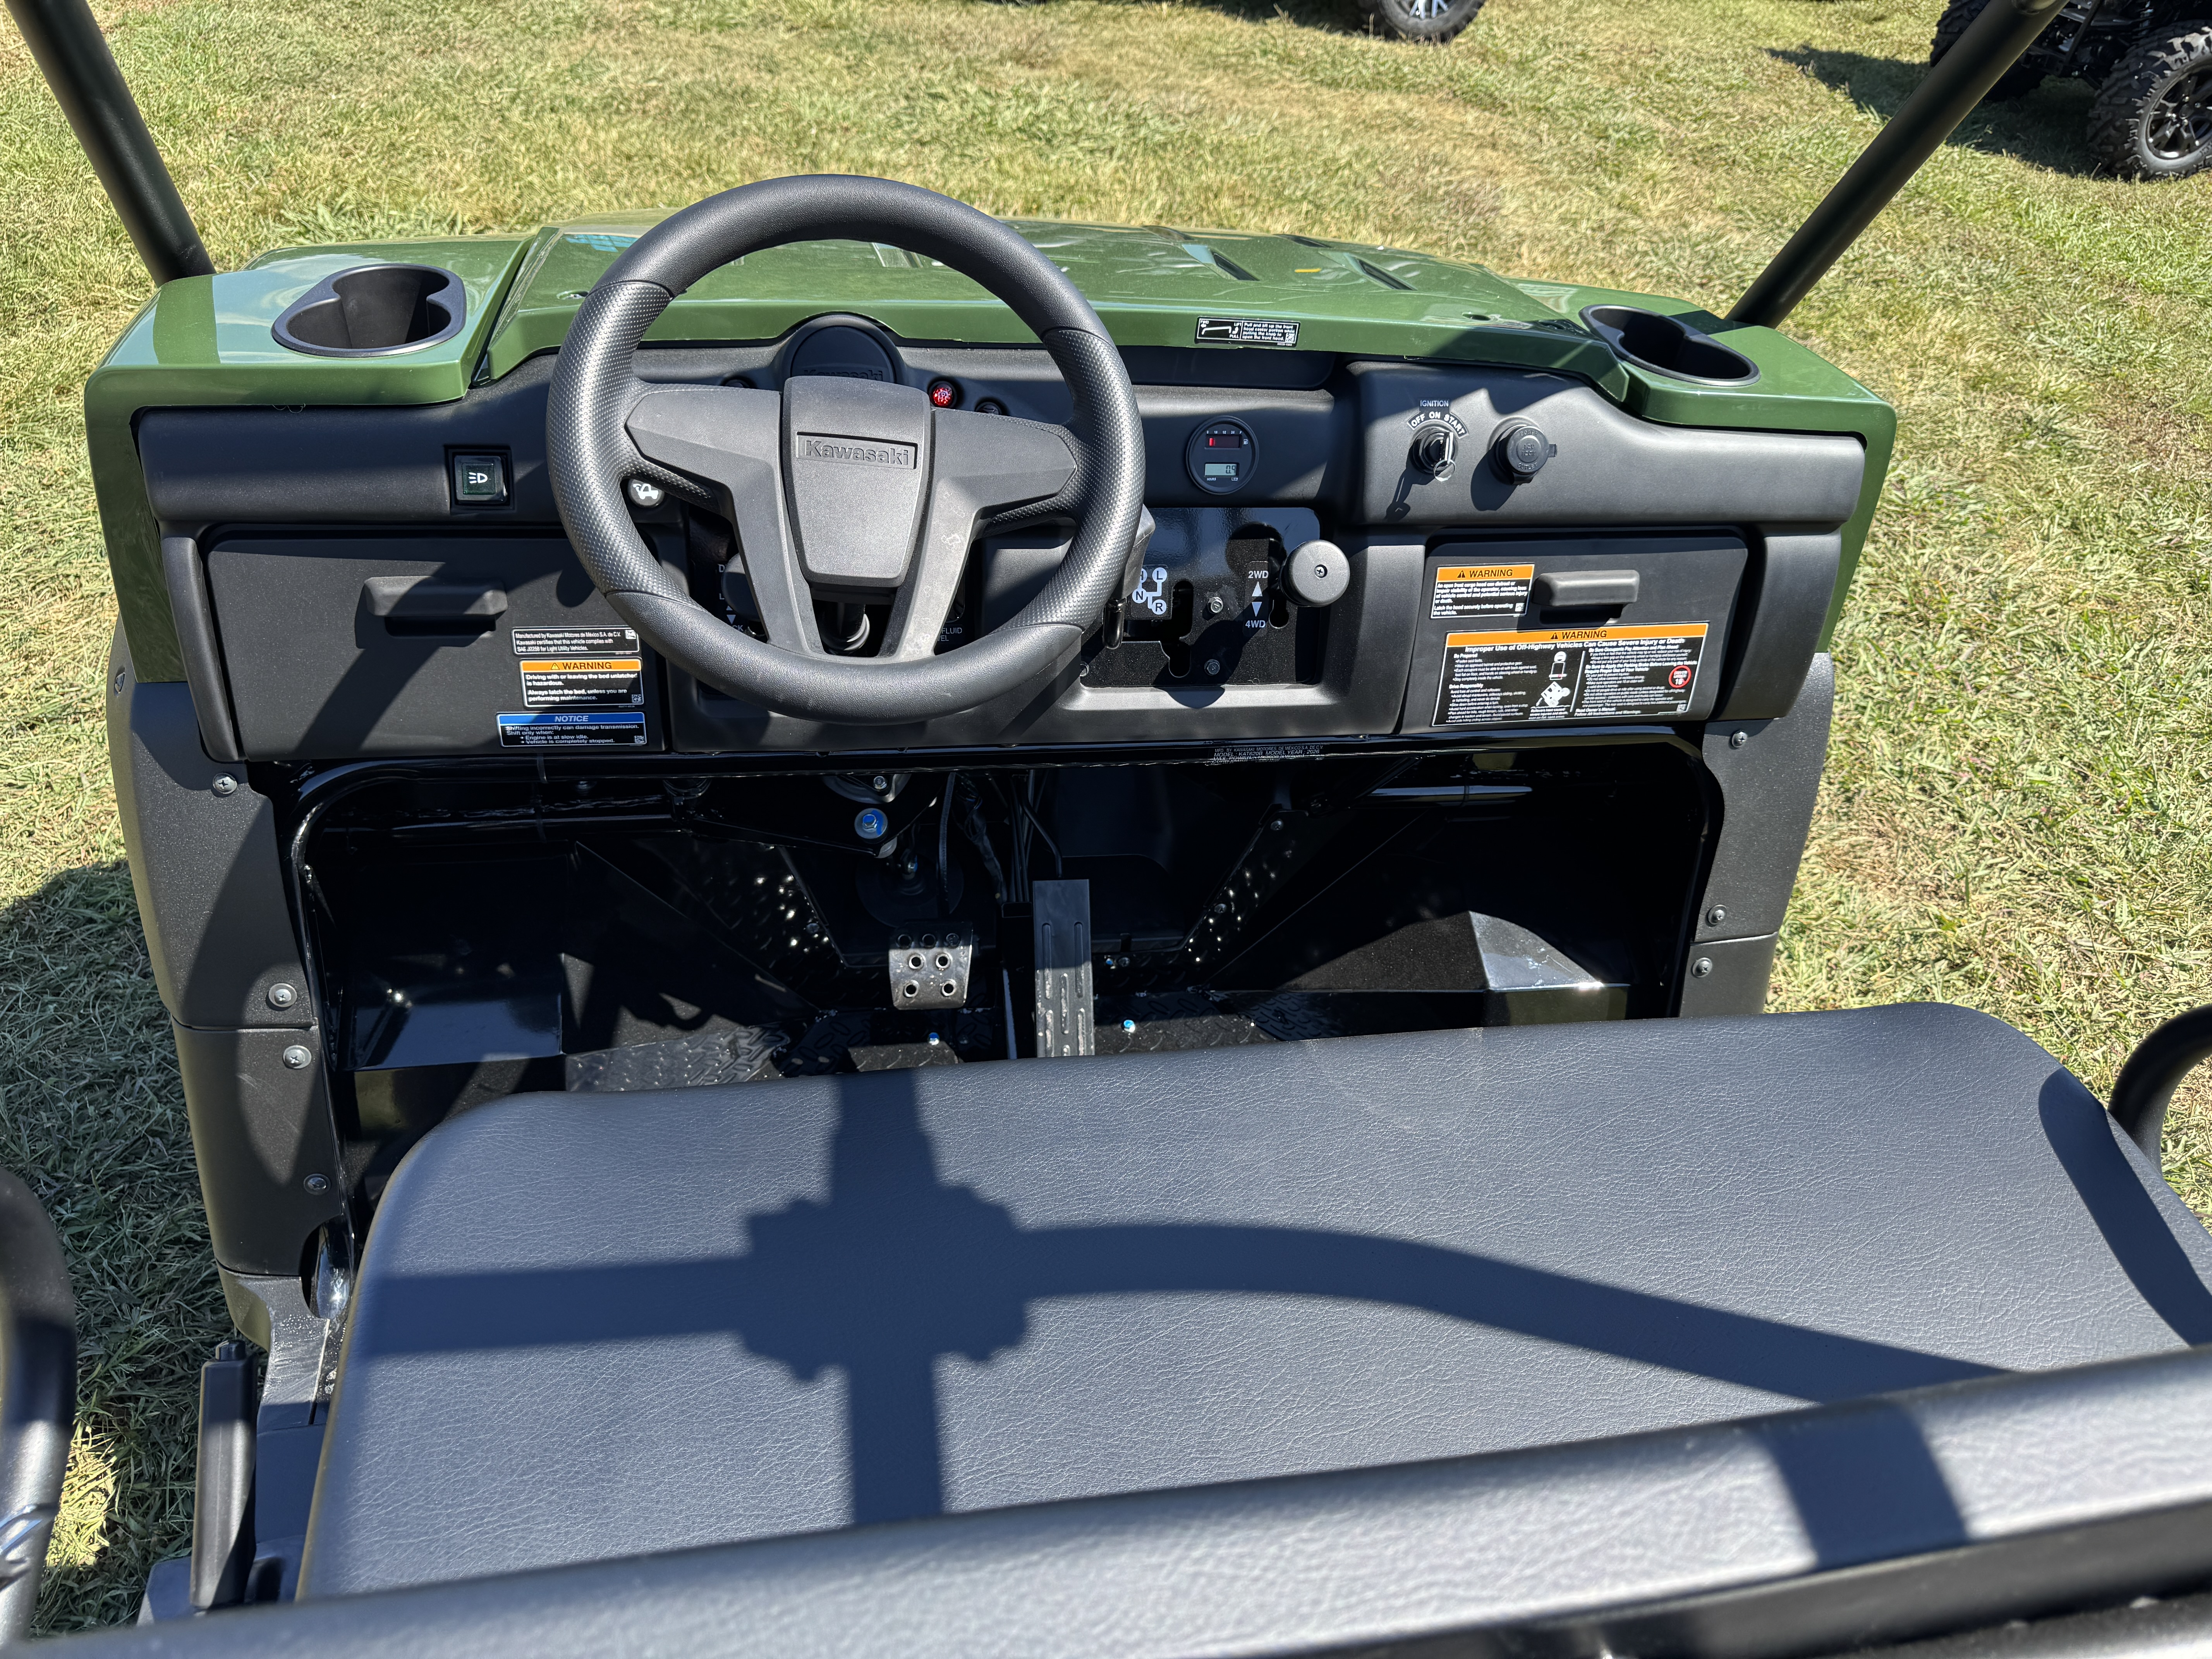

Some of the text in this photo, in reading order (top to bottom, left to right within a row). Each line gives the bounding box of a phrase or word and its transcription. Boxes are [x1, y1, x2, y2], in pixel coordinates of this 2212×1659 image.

[1411, 411, 1465, 434] OFF ON START
[805, 440, 908, 465] Kawasaki
[1518, 462, 1537, 470] OUTLET
[1156, 570, 1163, 580] L
[1248, 570, 1269, 579] 2WD
[1469, 569, 1513, 578] WARNING
[1136, 591, 1143, 600] N
[1155, 603, 1163, 612] R
[1562, 630, 1607, 639] WARNING
